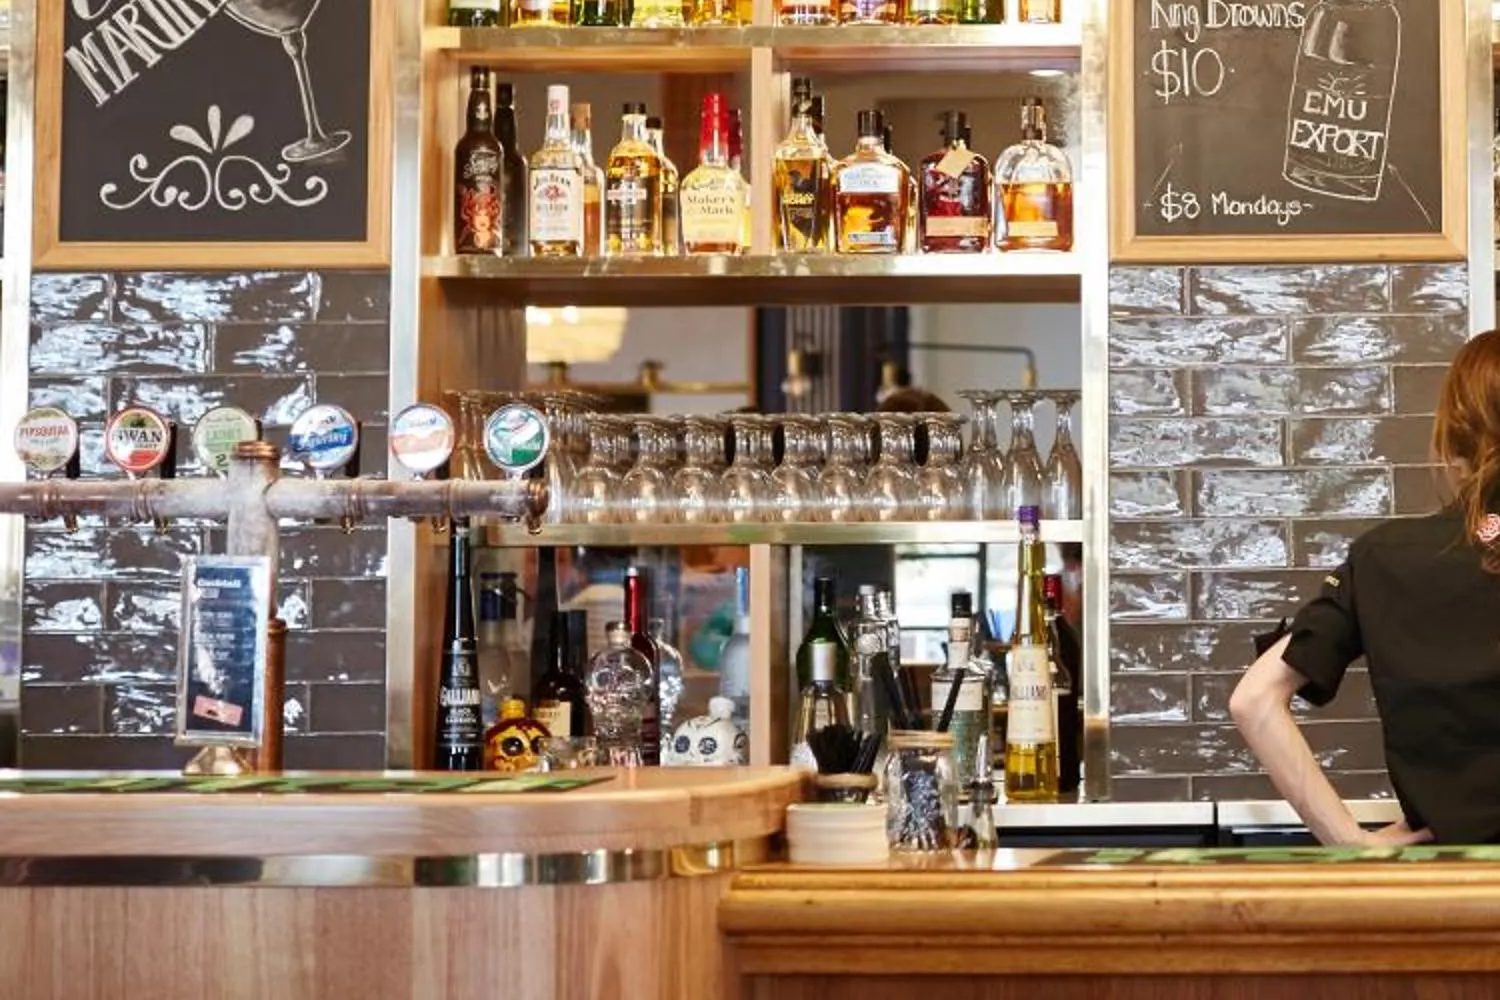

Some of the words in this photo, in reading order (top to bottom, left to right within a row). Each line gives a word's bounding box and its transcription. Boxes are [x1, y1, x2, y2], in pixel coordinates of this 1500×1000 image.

[1151, 40, 1225, 104] $10
[1303, 90, 1367, 121] EMU
[1290, 118, 1385, 160] EXPORT
[1160, 182, 1200, 223] $8
